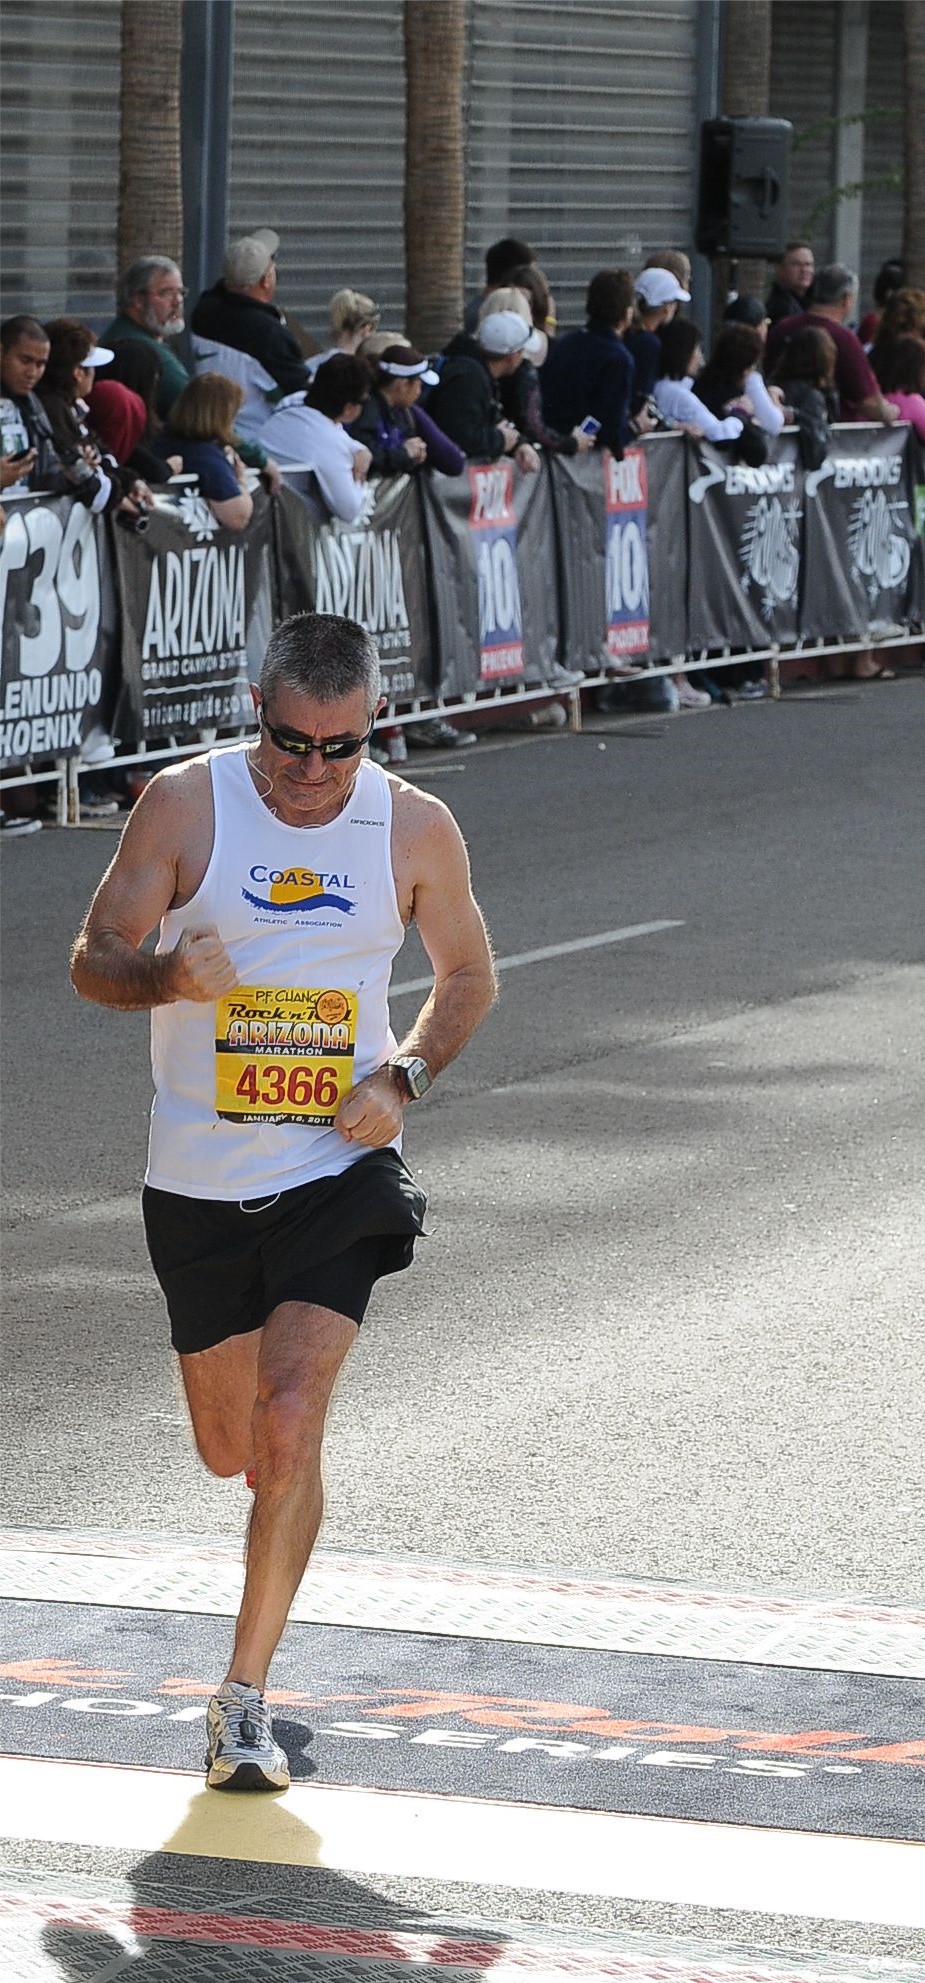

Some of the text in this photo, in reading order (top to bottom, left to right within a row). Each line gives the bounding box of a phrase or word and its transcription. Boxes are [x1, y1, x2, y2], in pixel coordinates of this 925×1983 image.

[474, 470, 509, 522] FOX
[609, 455, 645, 505] FOX
[479, 538, 517, 634] 10
[609, 520, 646, 612] 10
[142, 544, 246, 660] ARIZONA
[0, 668, 102, 720] EMUNDO
[350, 818, 385, 827] BROOKS
[250, 865, 355, 889] COASTAL
[253, 917, 342, 928] ATHLETIC ASSOCIATION
[228, 1020, 349, 1050] ARIZONA
[255, 1046, 323, 1056] MARATHON
[235, 1064, 338, 1107] 4366
[243, 1114, 287, 1122] JANUARY
[308, 1116, 332, 1124] 2011
